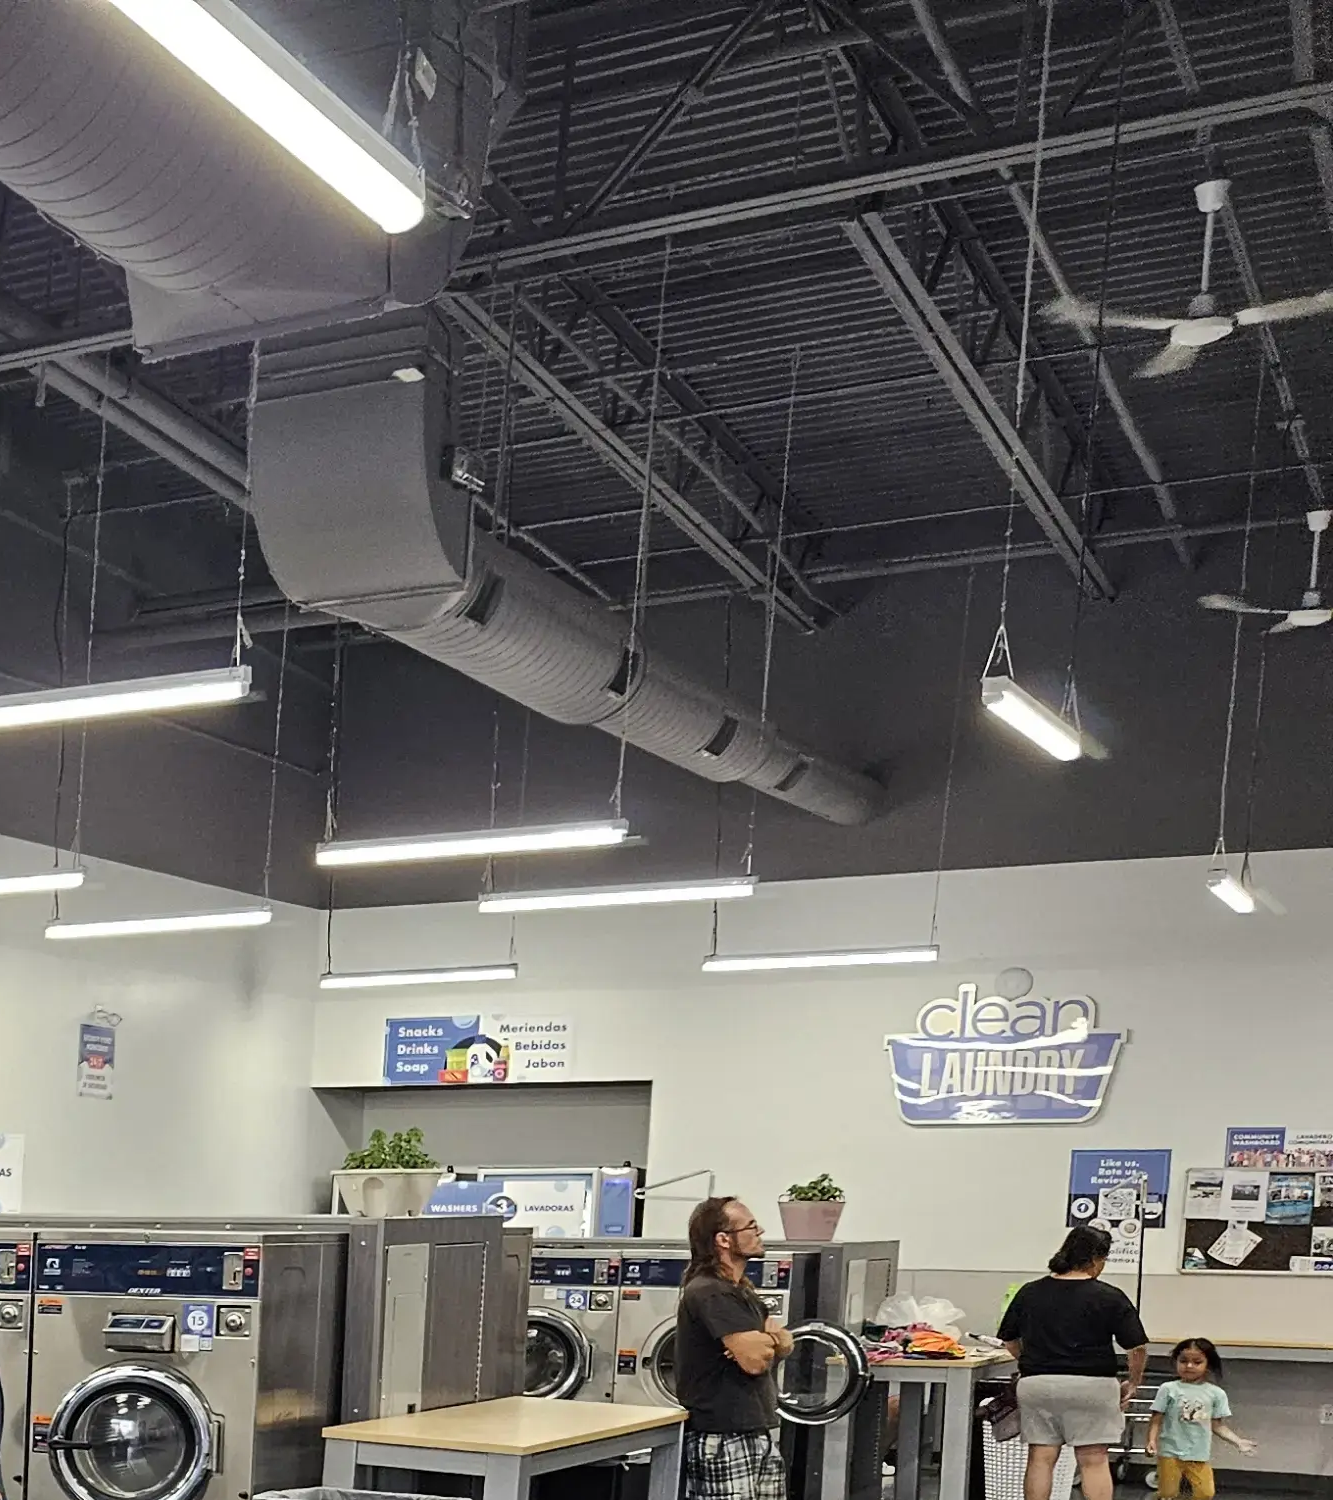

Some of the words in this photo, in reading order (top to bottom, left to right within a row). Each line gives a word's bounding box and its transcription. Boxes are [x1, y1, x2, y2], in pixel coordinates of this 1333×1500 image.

[919, 988, 1091, 1039] clean
[397, 1025, 444, 1038] Snacks
[499, 1021, 568, 1033] Meriendas
[396, 1042, 439, 1055] Drinks
[514, 1039, 567, 1051] Bebidas
[395, 1061, 429, 1075] Soap
[525, 1058, 565, 1069] Jabon
[918, 1048, 1086, 1098] LAUNDRY
[1100, 1159, 1122, 1167] Like
[1098, 1167, 1123, 1176] Rate
[430, 1205, 478, 1213] WASHERS
[496, 1199, 508, 1214] 3
[191, 1316, 205, 1326] 15
